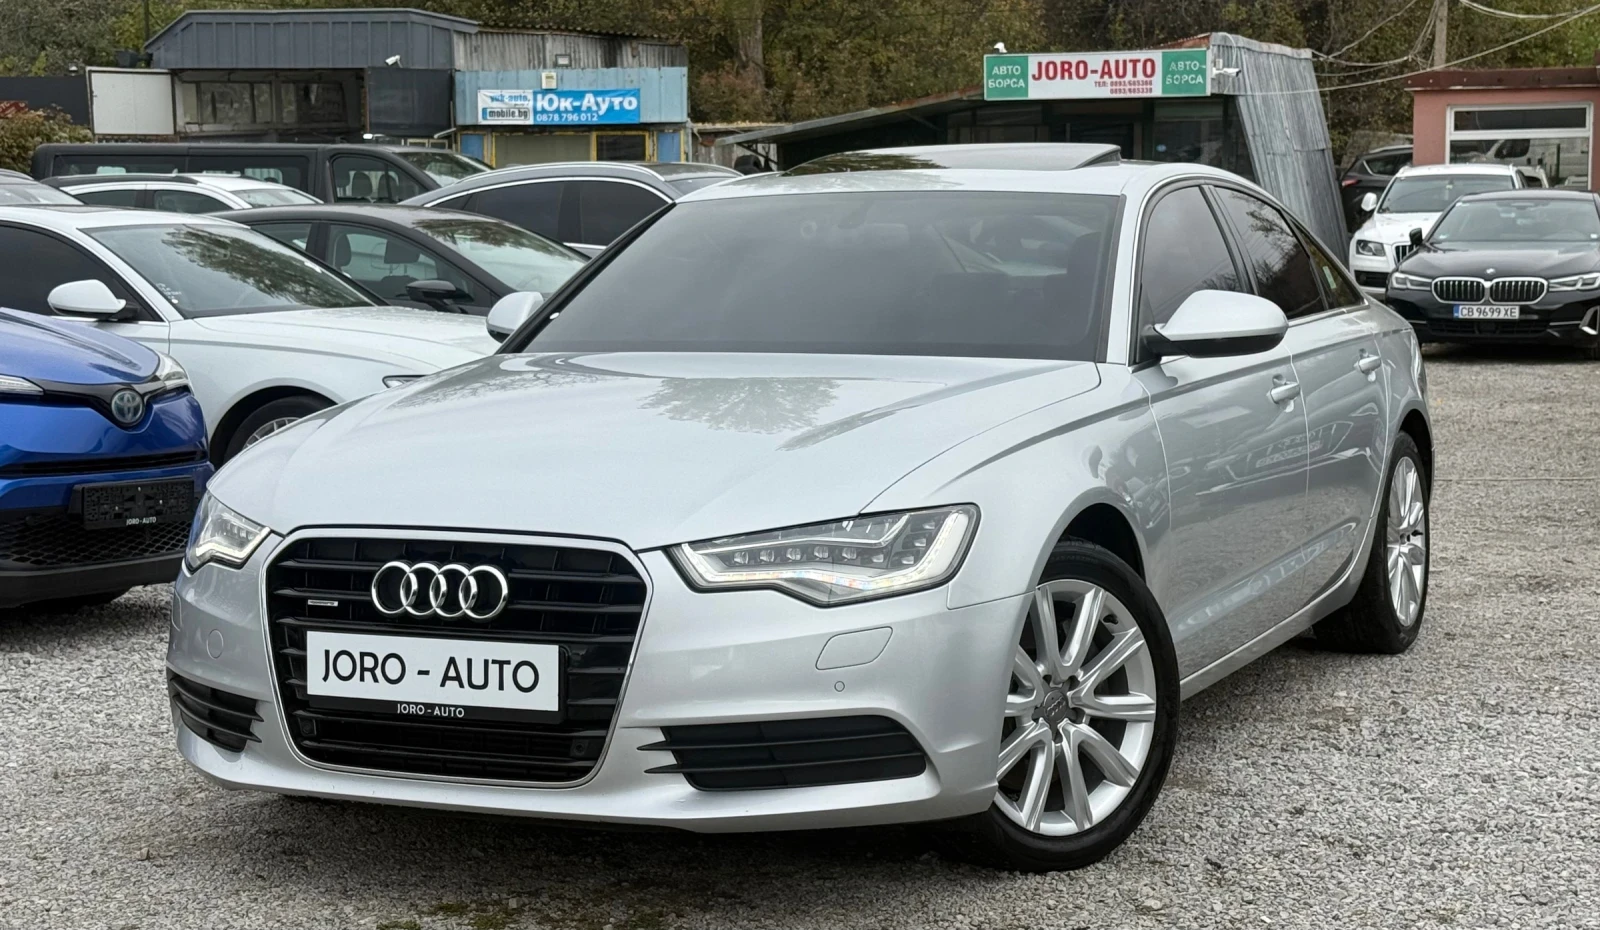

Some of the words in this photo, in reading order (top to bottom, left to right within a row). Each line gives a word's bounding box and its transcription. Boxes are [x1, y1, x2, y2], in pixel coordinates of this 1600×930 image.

[992, 65, 1021, 75] АВТО
[1031, 58, 1157, 81] JORO-AUTO
[1169, 60, 1200, 71] АВТО
[988, 78, 1025, 88] БОРСА
[1165, 74, 1204, 85] БОРСА
[536, 93, 638, 116] Юк-Ауто
[488, 109, 528, 120] mobile.bg
[536, 113, 559, 122] 0878
[561, 113, 579, 122] 796
[580, 113, 598, 121] 012
[1461, 307, 1474, 317] CB
[1477, 307, 1501, 317] 9699
[1503, 307, 1517, 318] XE
[322, 649, 407, 685] JORO
[440, 656, 540, 693] AUTO
[397, 704, 425, 715] JORO
[433, 706, 465, 718] AUTO
